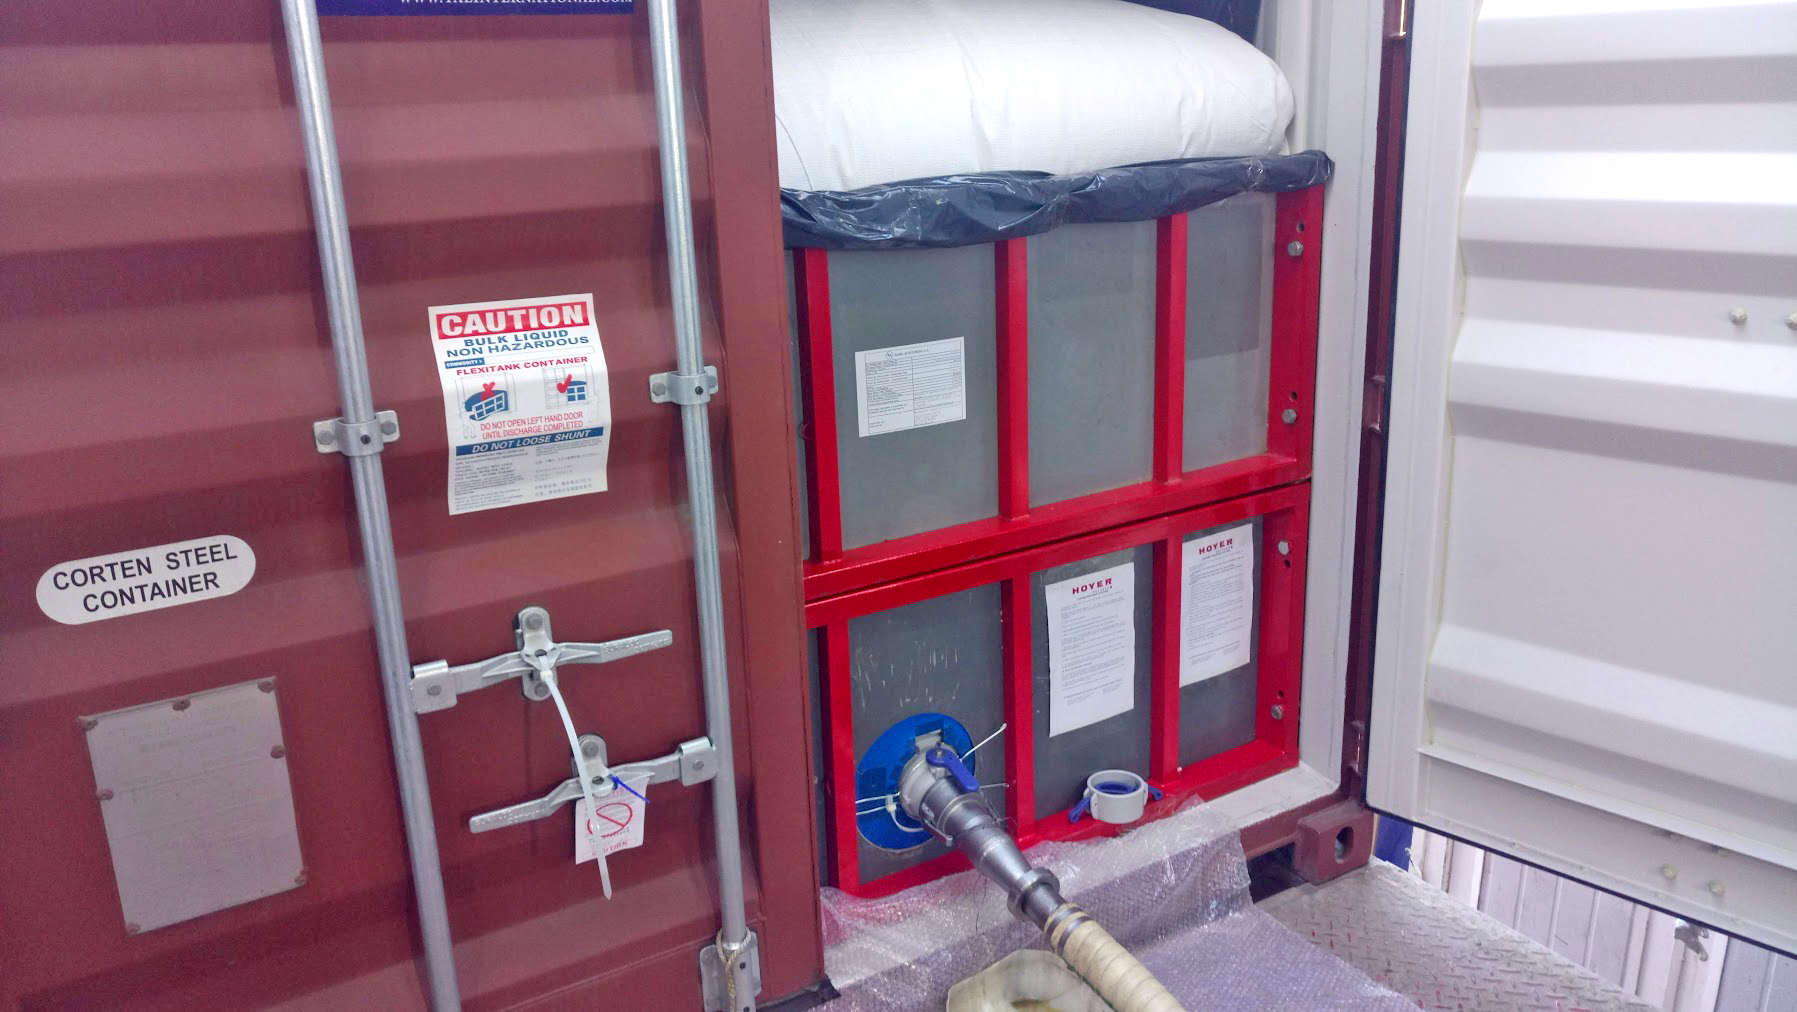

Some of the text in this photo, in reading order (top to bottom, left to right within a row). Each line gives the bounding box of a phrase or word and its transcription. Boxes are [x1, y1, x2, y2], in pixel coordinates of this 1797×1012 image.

[441, 304, 584, 336] CAUTION
[446, 336, 590, 358] NON HAZARDOUS
[464, 329, 569, 348] BULK LIQUID
[446, 359, 478, 368] COMMODITY
[456, 356, 589, 376] FLEXITANK CONTAINER
[480, 411, 583, 431] DO NOT OPEN LEFT HAND DOOR
[482, 420, 584, 440] UNTIL DISCHARGE COMPLETED
[472, 429, 592, 453] DO NOT LOOSE SHUNT
[1199, 538, 1233, 555] HOYER
[53, 542, 238, 590] CORTEN STEEL
[83, 571, 220, 613] CONTAINER
[1072, 577, 1112, 595] HOYER
[592, 840, 628, 857] CUTION
